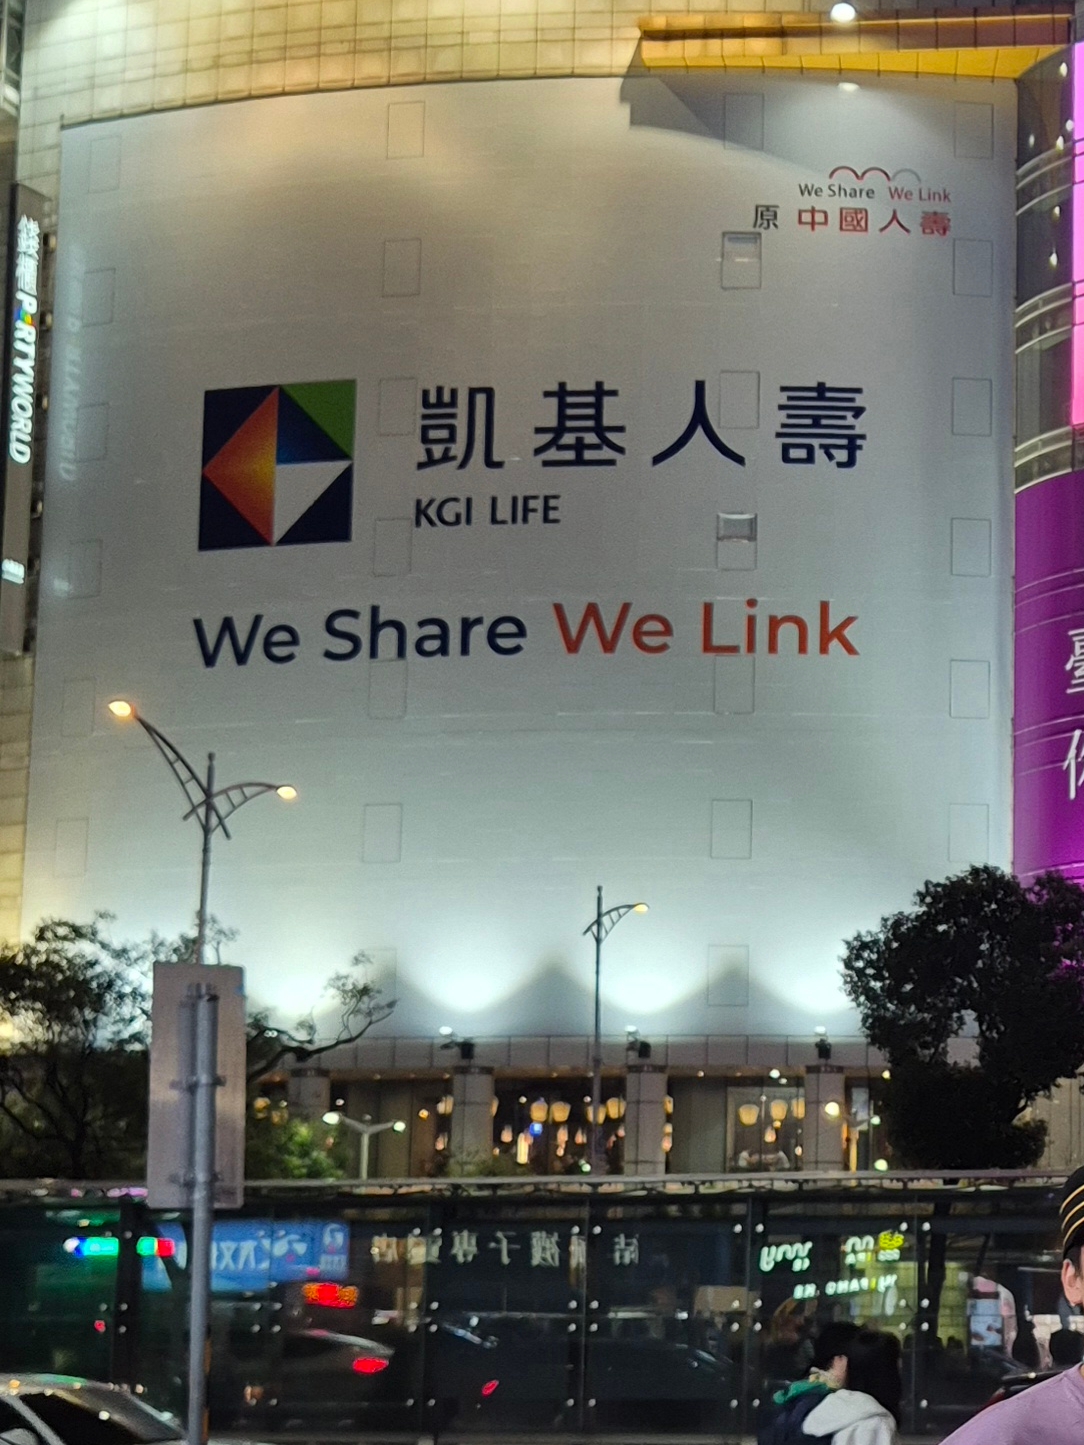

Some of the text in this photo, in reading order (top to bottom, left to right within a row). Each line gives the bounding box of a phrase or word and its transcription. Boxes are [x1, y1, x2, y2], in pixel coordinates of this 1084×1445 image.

[799, 183, 951, 203] We Share We Link
[752, 205, 952, 237] 原 中國人壽
[416, 379, 867, 470] 凱基人壽
[414, 495, 561, 528] KGI LIFE
[193, 595, 860, 668] We Share We Link
